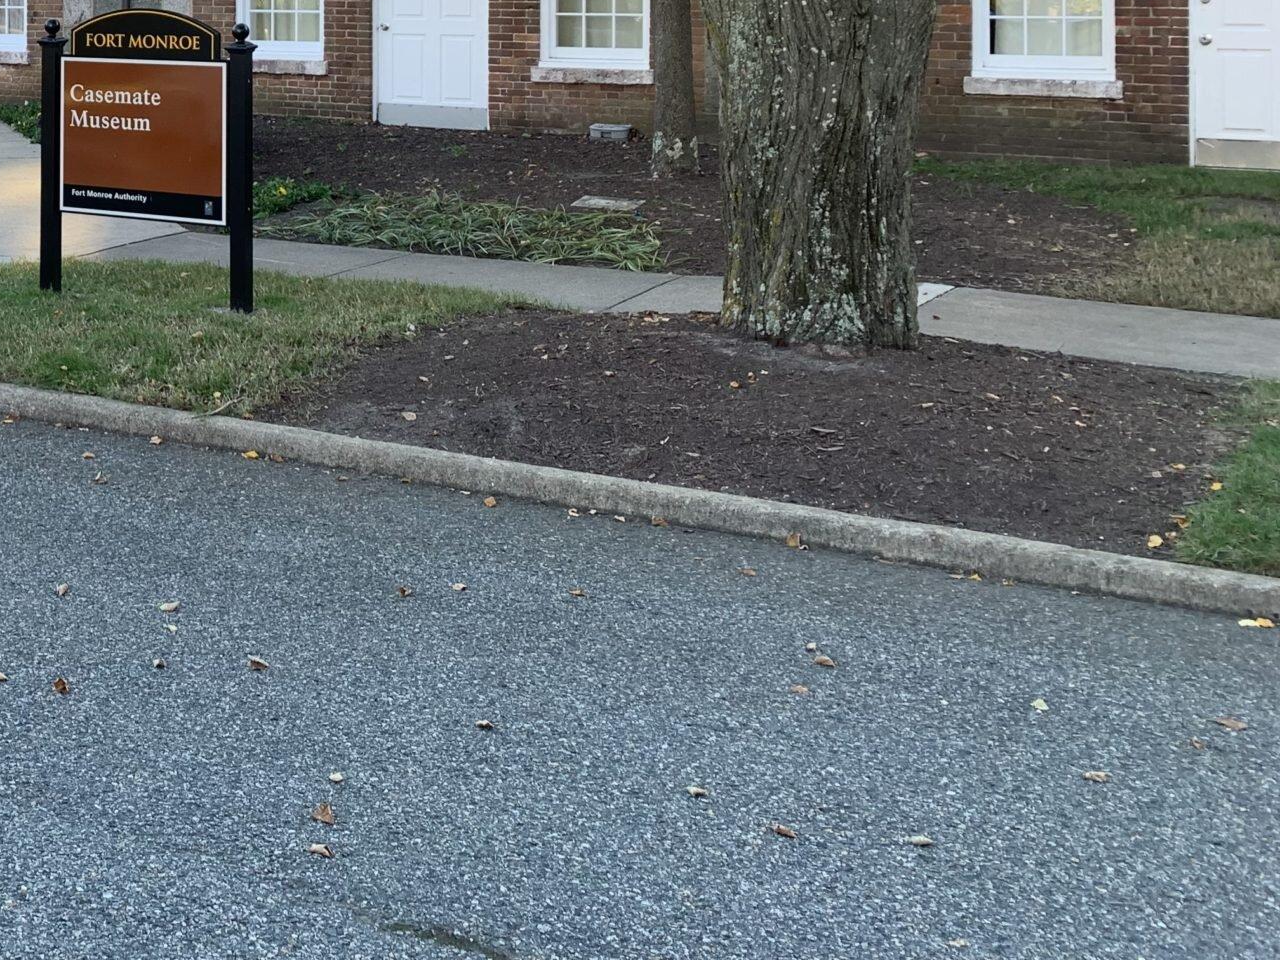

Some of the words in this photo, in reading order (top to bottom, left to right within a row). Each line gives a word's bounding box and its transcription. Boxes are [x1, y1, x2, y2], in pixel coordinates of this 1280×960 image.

[85, 33, 125, 47] FORT
[128, 34, 200, 50] MONROE
[69, 83, 161, 106] Casemate
[69, 109, 151, 131] Museum
[71, 188, 86, 197] Fort
[86, 190, 113, 199] Monroe
[114, 192, 147, 204] Authority
